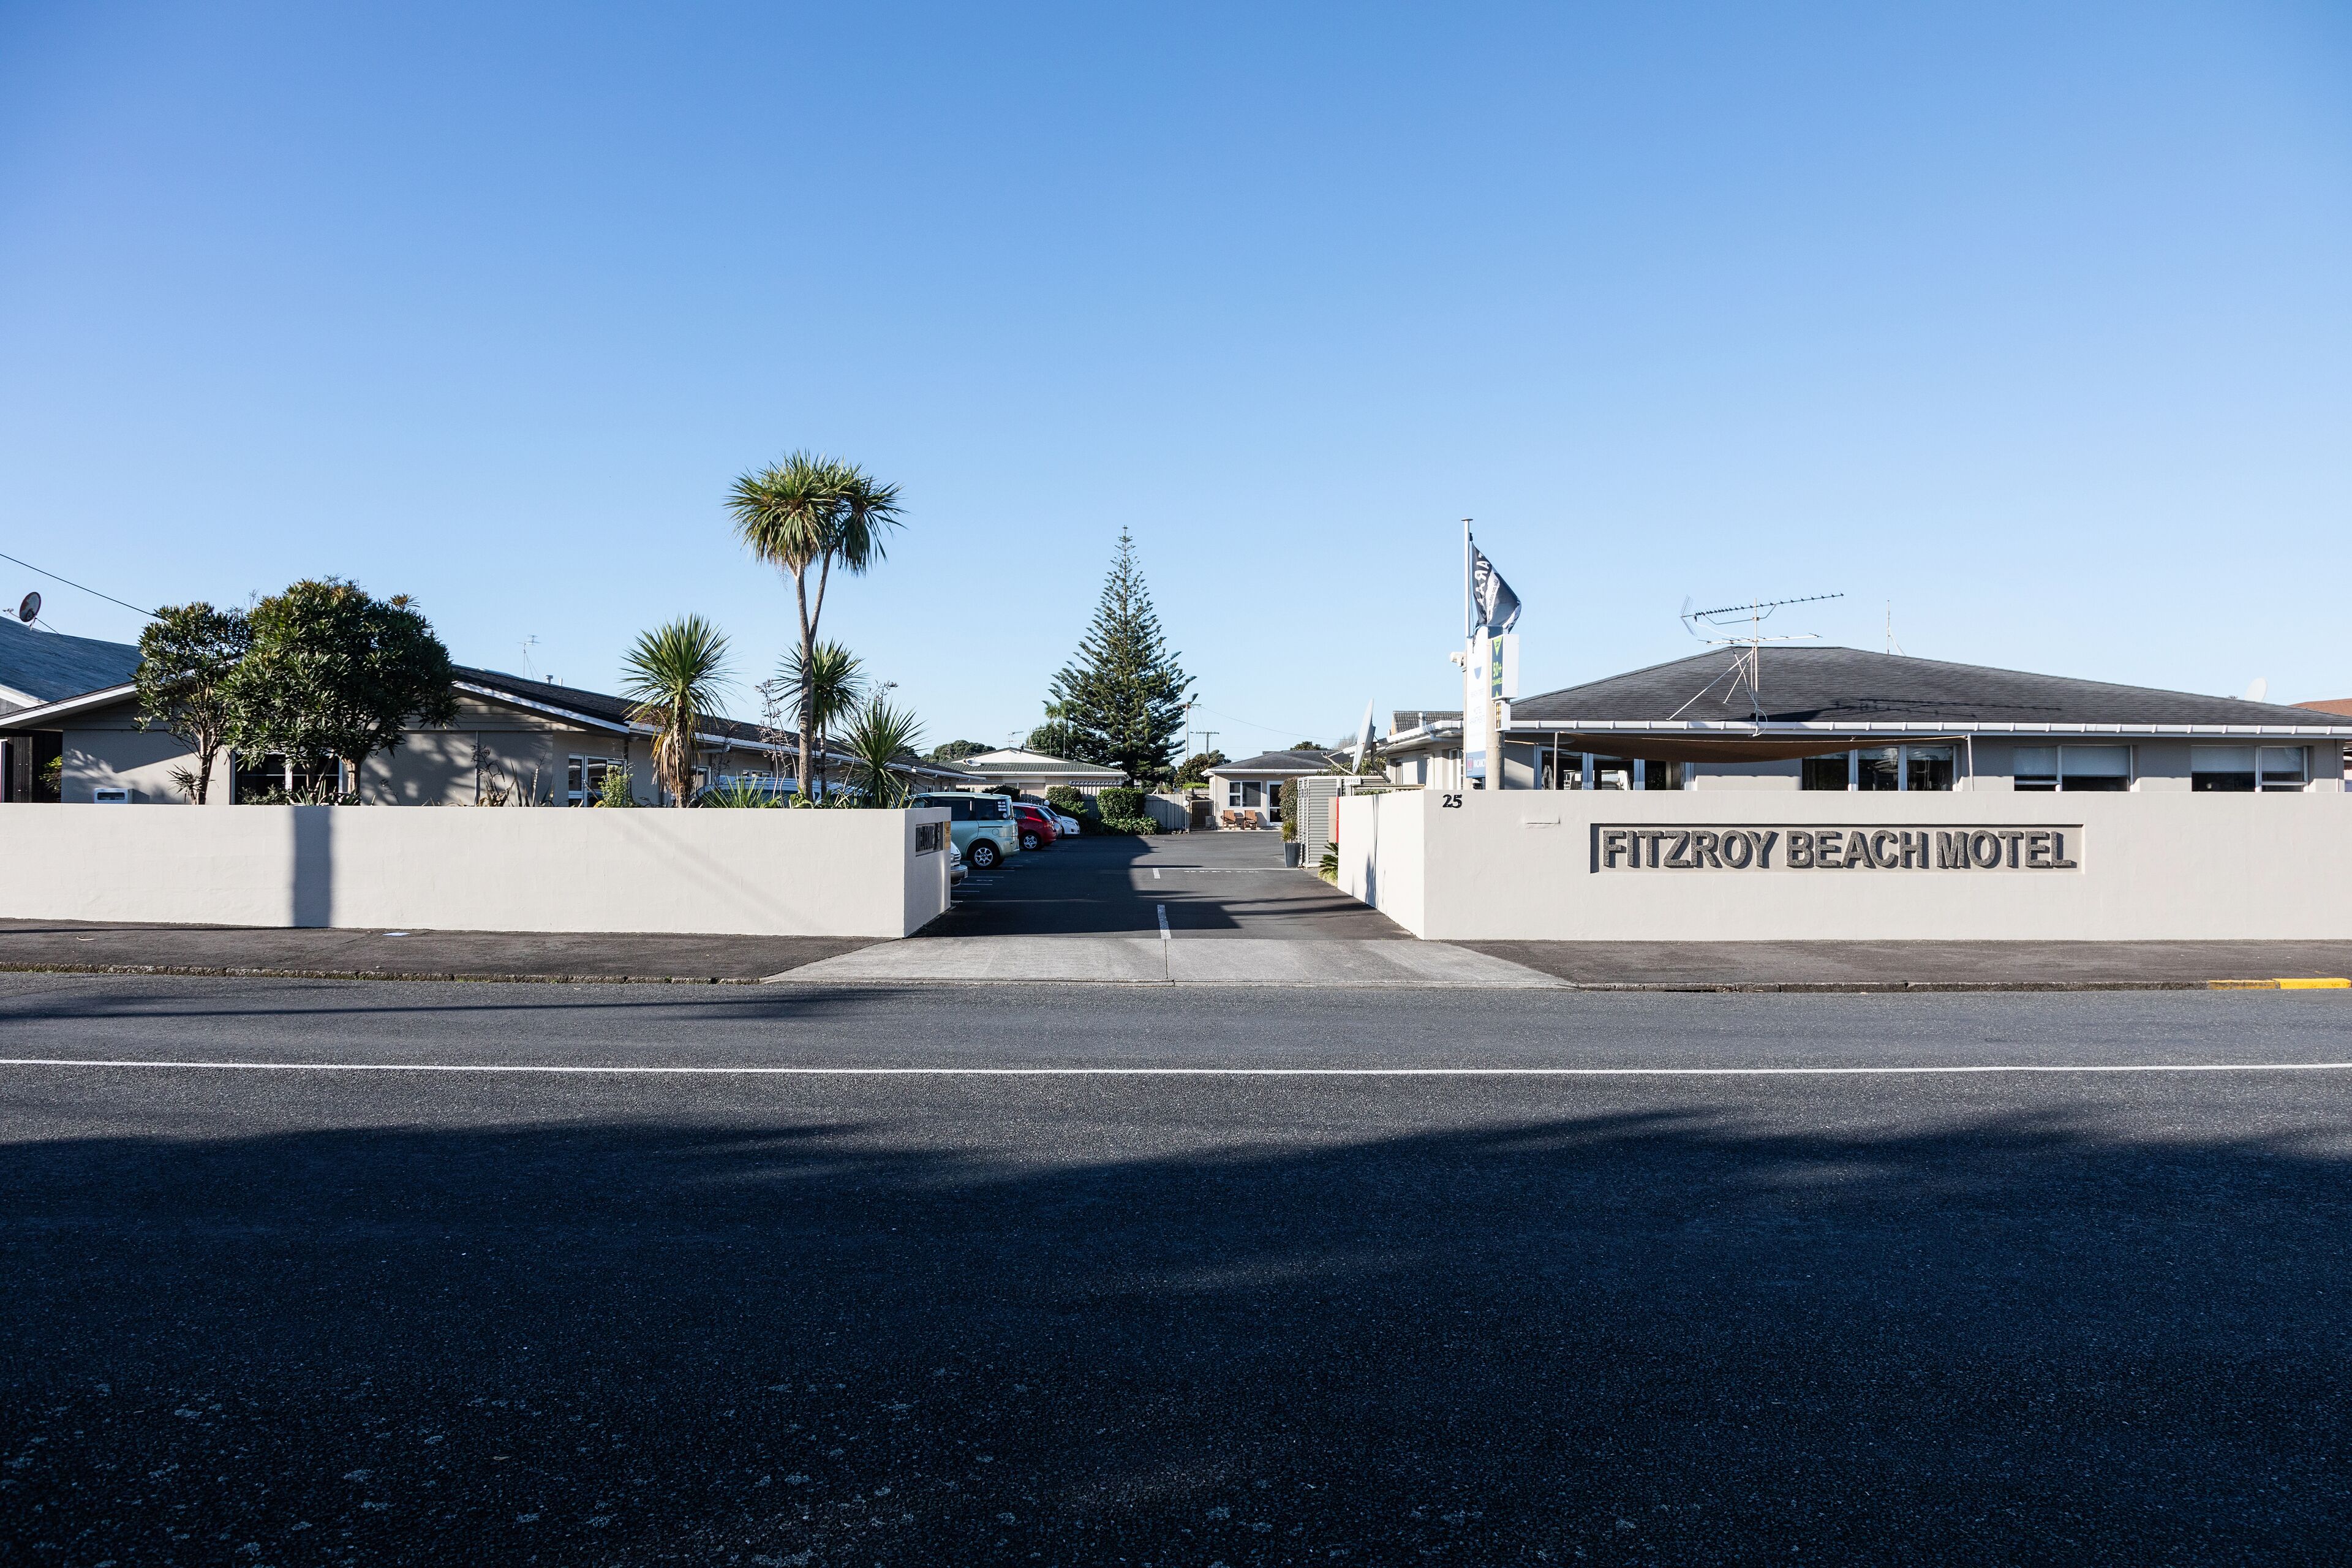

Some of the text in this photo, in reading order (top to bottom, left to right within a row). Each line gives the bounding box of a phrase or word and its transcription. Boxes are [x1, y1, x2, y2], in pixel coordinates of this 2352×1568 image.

[1493, 661, 1502, 677] 50+
[1474, 758, 1486, 767] VACANC
[1442, 794, 1463, 809] 25
[1602, 830, 2074, 868] FITZROY BEACH MOTEL
